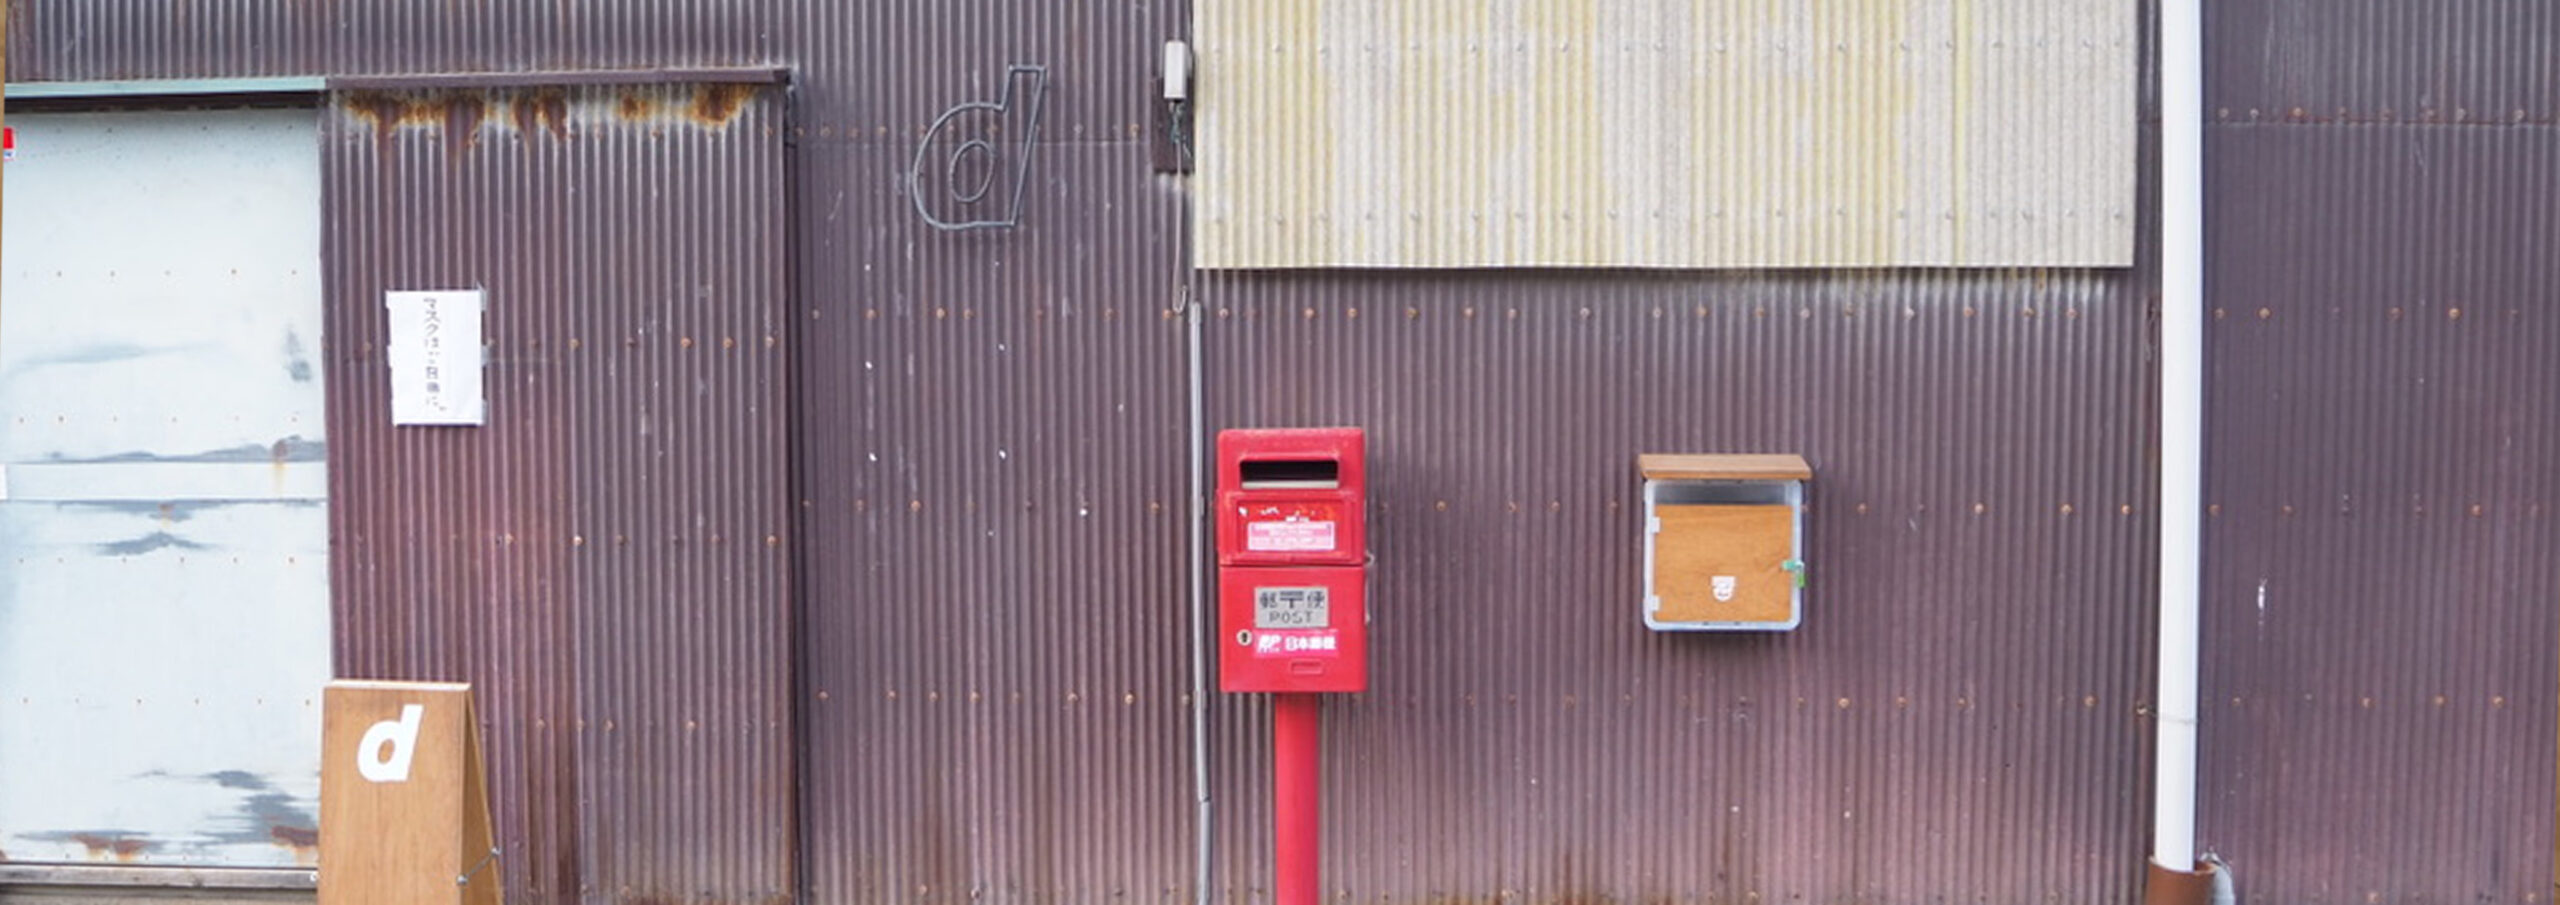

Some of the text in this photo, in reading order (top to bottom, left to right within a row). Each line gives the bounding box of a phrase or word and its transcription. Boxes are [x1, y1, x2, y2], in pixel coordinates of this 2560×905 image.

[913, 65, 1046, 229] d
[1269, 611, 1313, 624] POST
[357, 704, 424, 782] d
